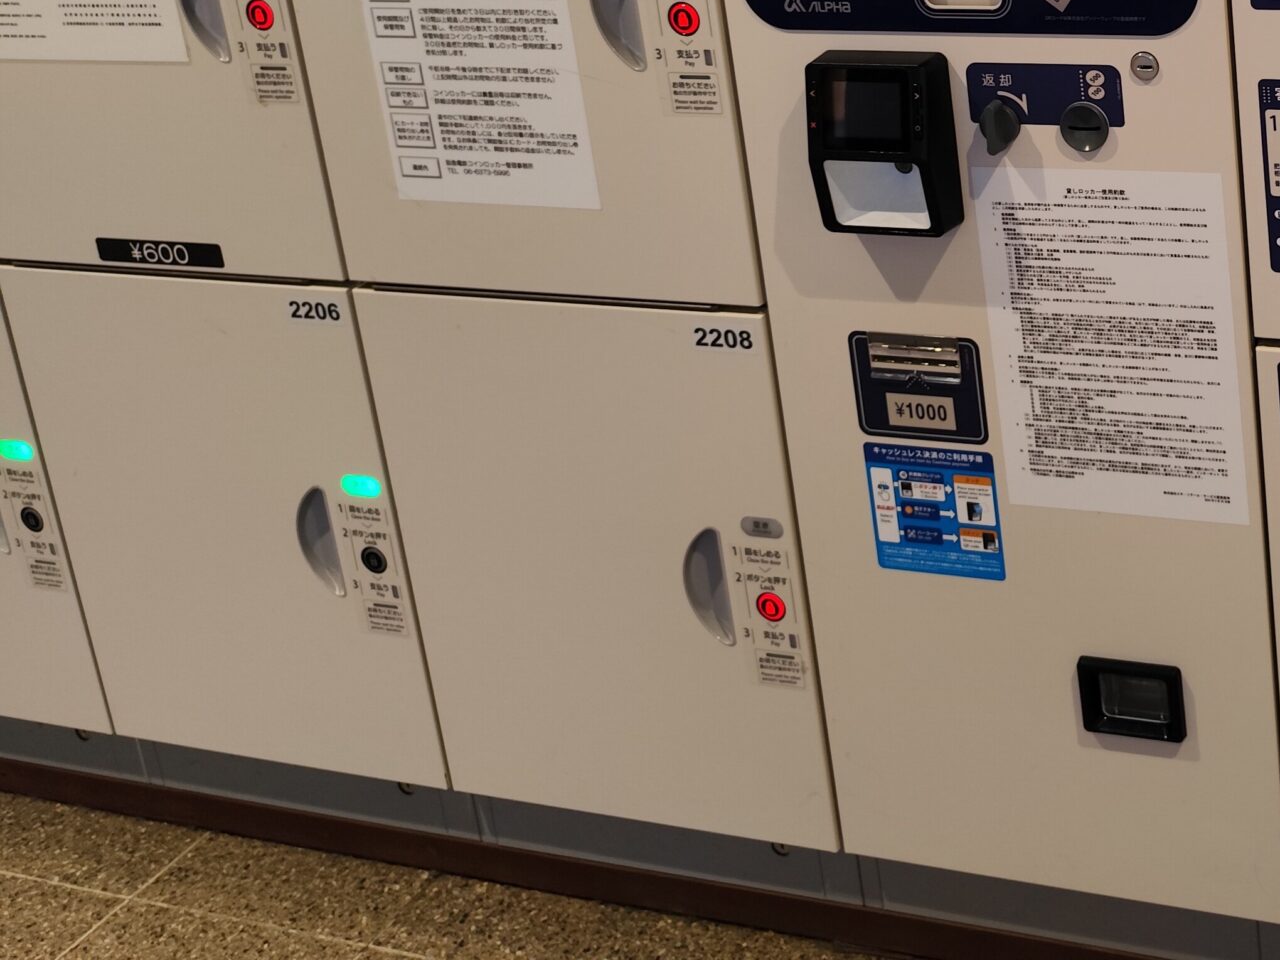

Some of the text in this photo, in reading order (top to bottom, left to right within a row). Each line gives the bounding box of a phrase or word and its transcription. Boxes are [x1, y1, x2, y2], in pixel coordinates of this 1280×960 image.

[982, 73, 1012, 87] 返却
[1269, 115, 1278, 132] 1
[129, 241, 189, 264] ¥600
[289, 301, 340, 321] 2206
[694, 327, 753, 349] 2208
[894, 400, 948, 422] ¥1000
